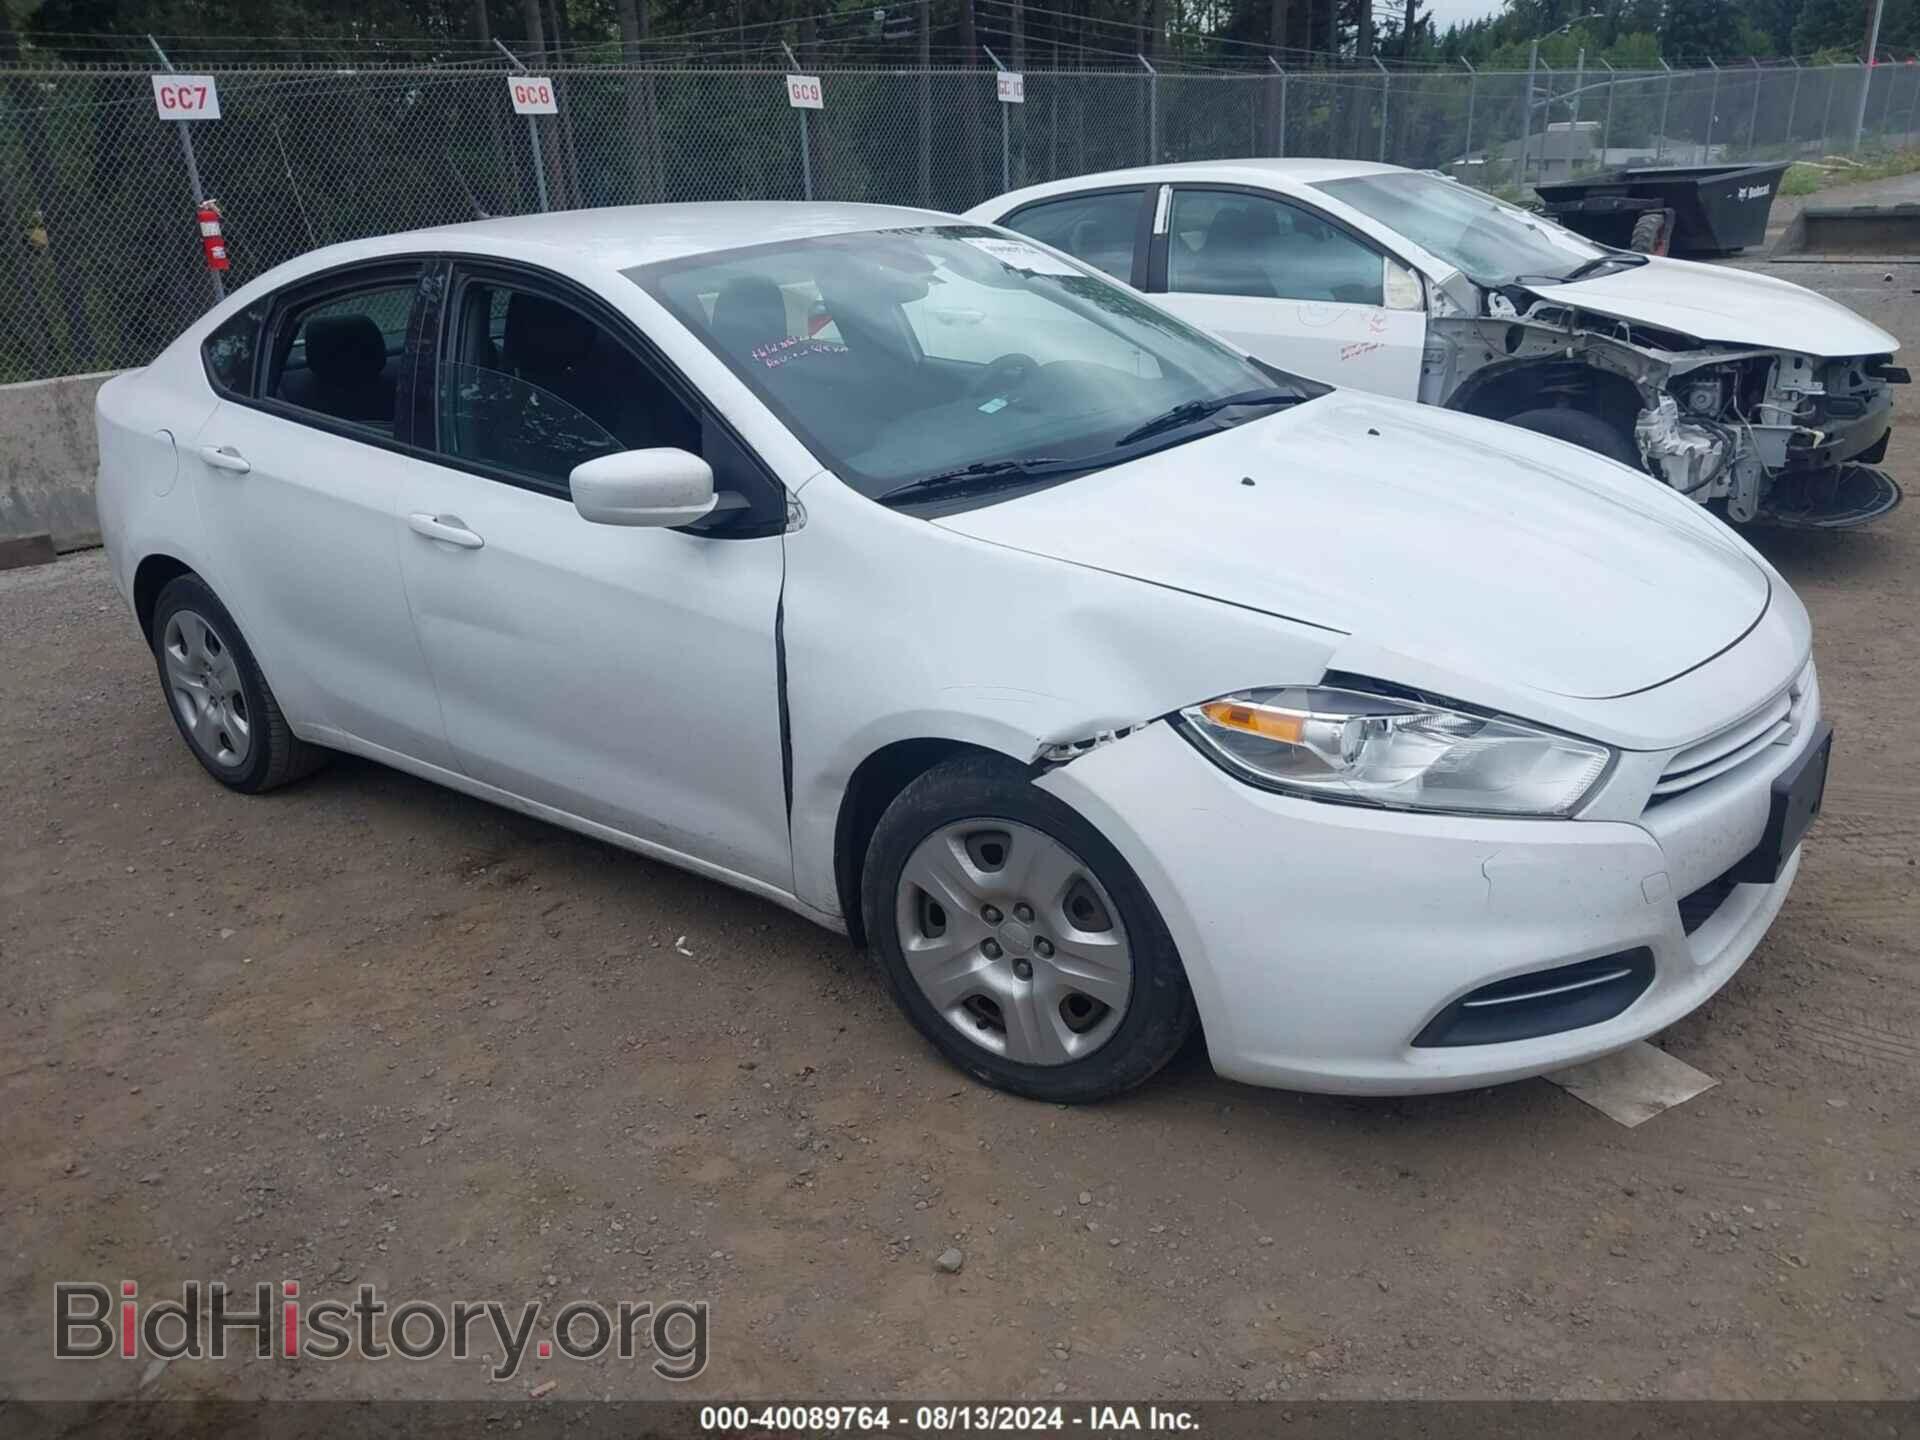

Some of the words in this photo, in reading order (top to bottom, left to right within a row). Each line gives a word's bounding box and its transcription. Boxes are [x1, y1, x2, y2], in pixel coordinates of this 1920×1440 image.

[160, 86, 207, 110] GC7
[515, 85, 549, 104] GC8
[792, 84, 819, 101] GC9
